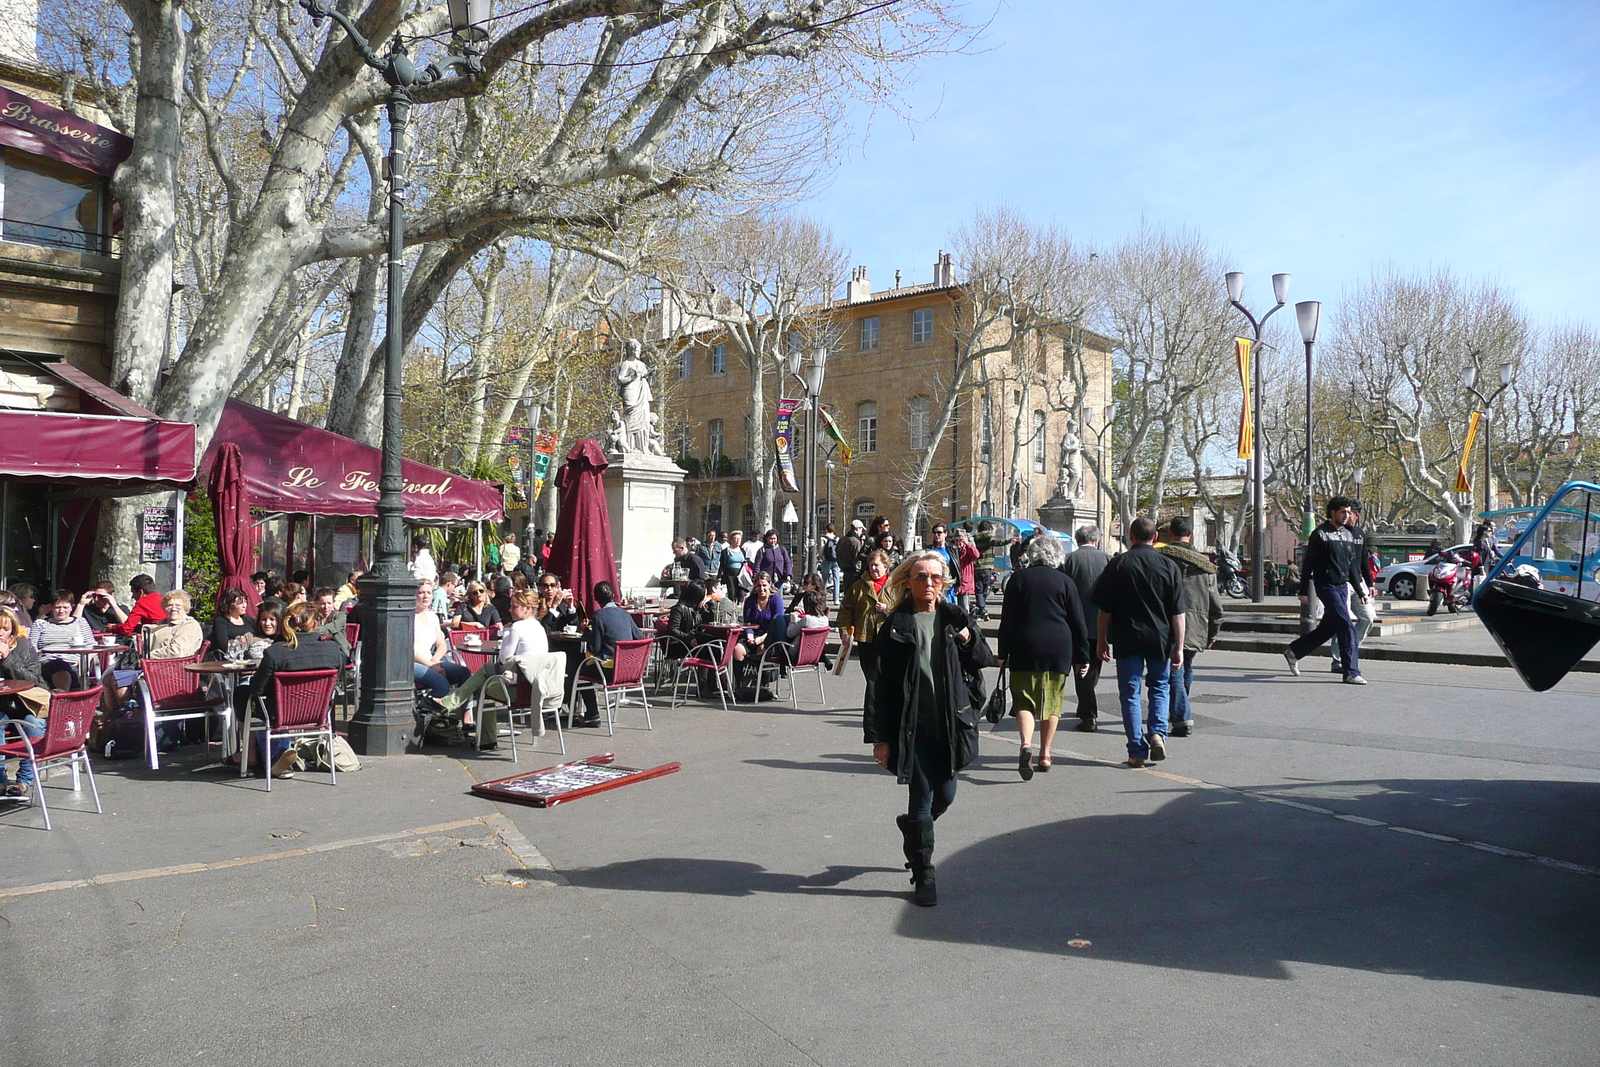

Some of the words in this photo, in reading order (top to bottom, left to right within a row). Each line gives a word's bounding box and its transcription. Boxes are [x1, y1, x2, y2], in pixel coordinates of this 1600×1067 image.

[1, 101, 113, 148] Brasserie
[282, 466, 326, 489] Le
[339, 470, 453, 495] Feival
